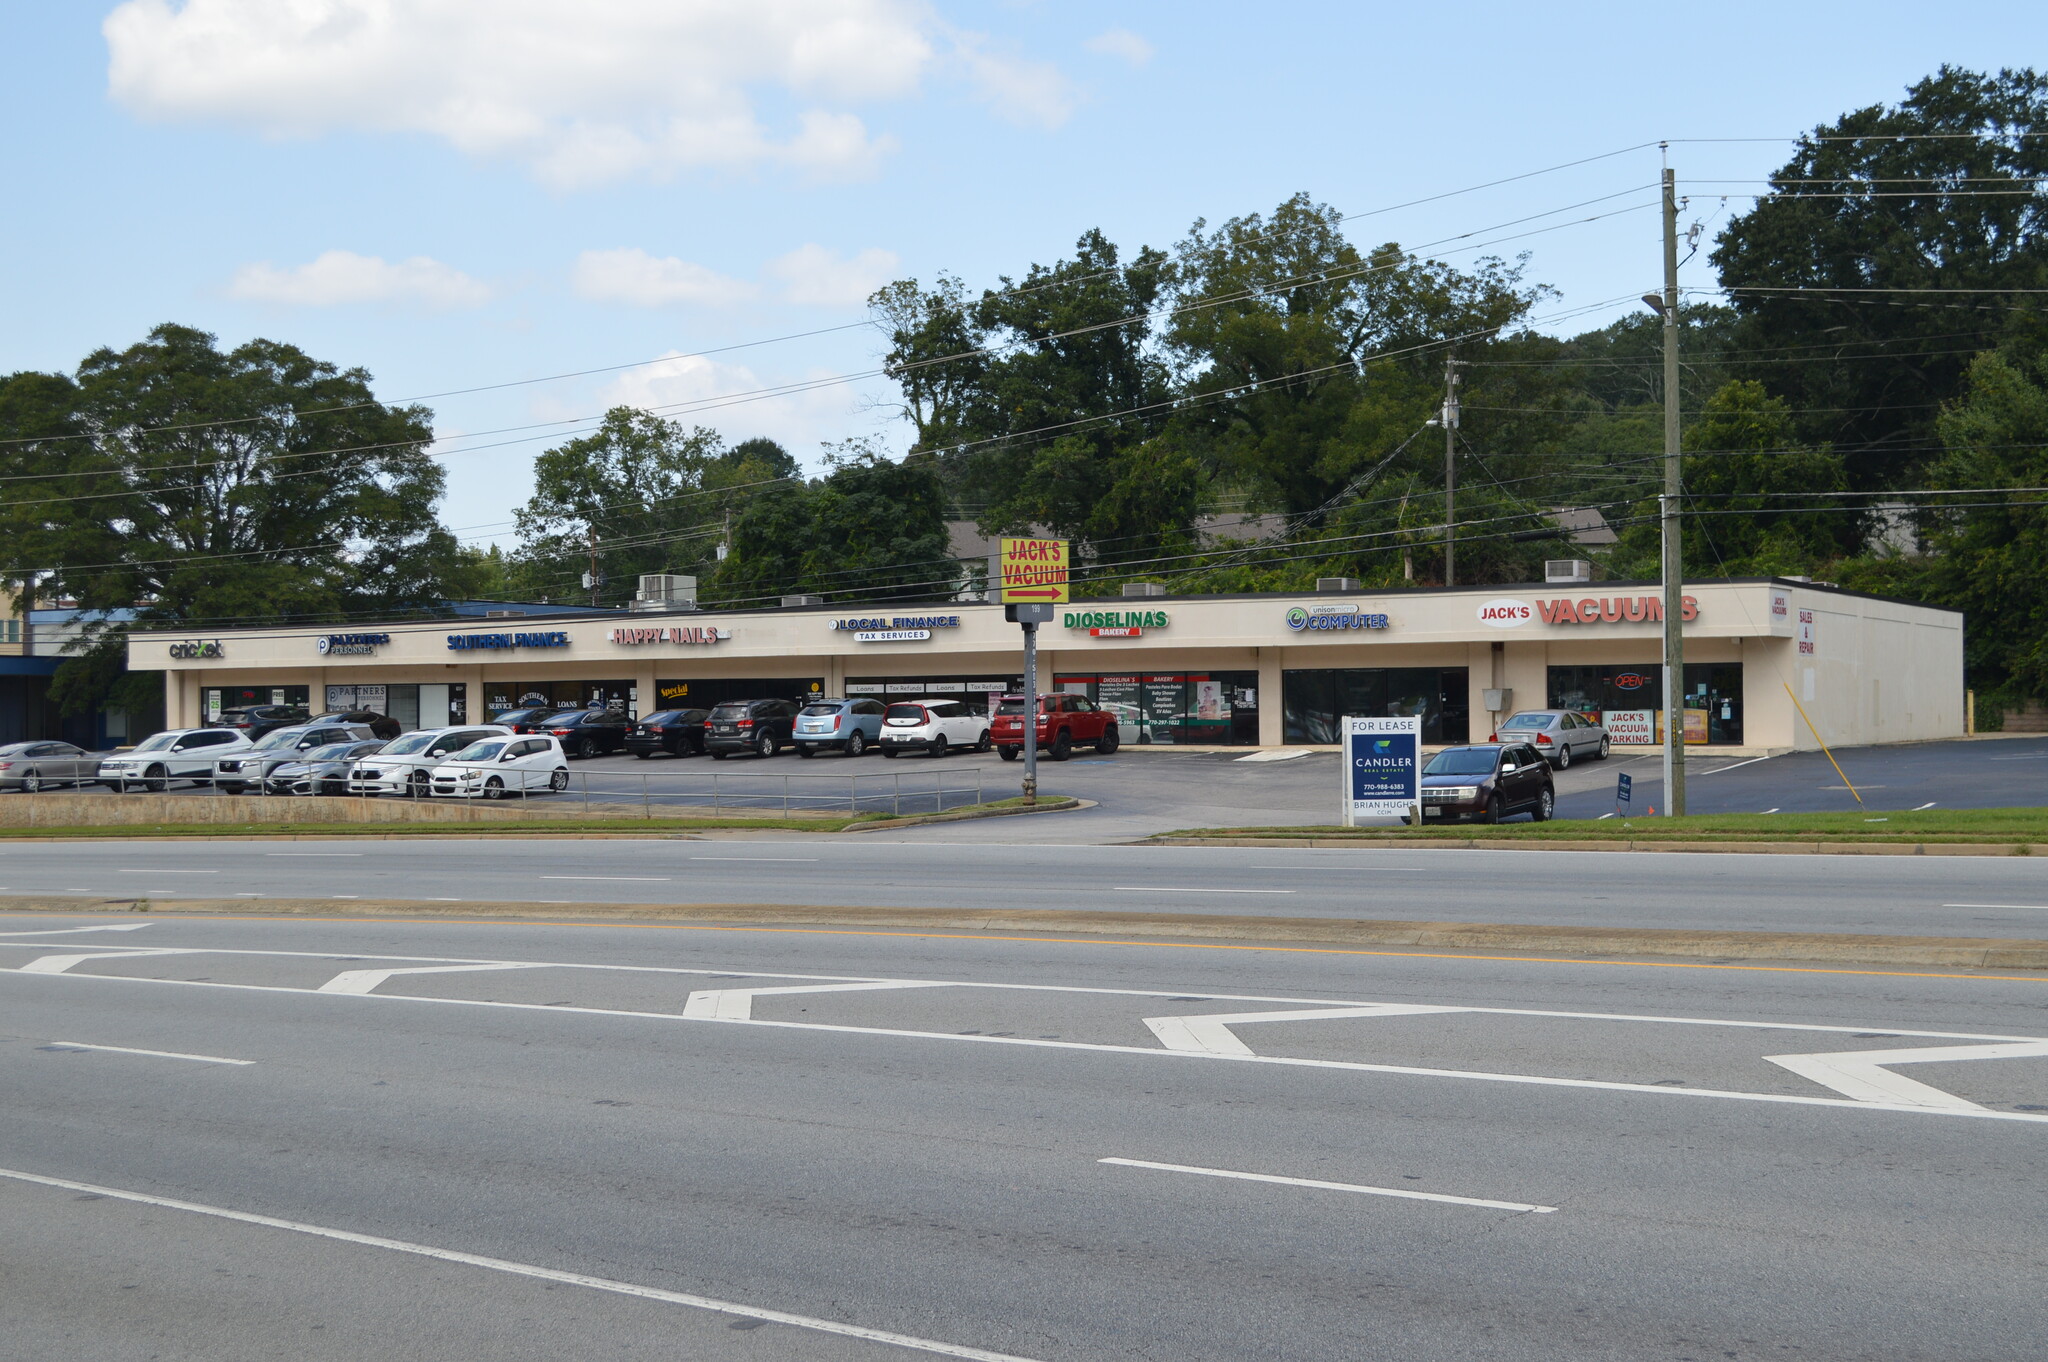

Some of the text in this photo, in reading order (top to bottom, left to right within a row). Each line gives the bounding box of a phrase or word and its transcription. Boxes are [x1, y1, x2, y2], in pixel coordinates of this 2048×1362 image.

[1009, 540, 1061, 562] JACK'S
[1003, 564, 1067, 585] VACUUM
[1031, 604, 1041, 613] 199
[1481, 595, 1698, 623] JACK'S VACUUMS
[839, 616, 961, 630] LOCAL FINANCE
[1063, 611, 1169, 629] DIOSELINA'S
[1308, 613, 1389, 631] COMPUTER
[1800, 611, 1812, 624] SALES
[613, 627, 718, 645] HAPPY NAILS
[880, 631, 925, 639] SERVICES
[1098, 628, 1131, 636] BAKERY
[447, 631, 570, 650] SOUTHERN FINANCE
[169, 640, 223, 658] cricket
[331, 646, 373, 654] PERSONNEL
[1799, 641, 1813, 654] REPAIR
[1615, 676, 1643, 687] OPEN
[339, 687, 385, 695] PARTNERS
[660, 684, 688, 698] Special
[899, 684, 922, 692] Refunds
[518, 692, 549, 705] SOUTHERN
[211, 701, 220, 709] 25
[1611, 713, 1645, 722] JACK'S
[1352, 721, 1414, 731] FOR LEASE
[1608, 724, 1649, 733] VACUUM
[1609, 735, 1649, 744] PARKING
[1355, 758, 1412, 767] CANDLER
[1354, 801, 1381, 809] BRIAN
